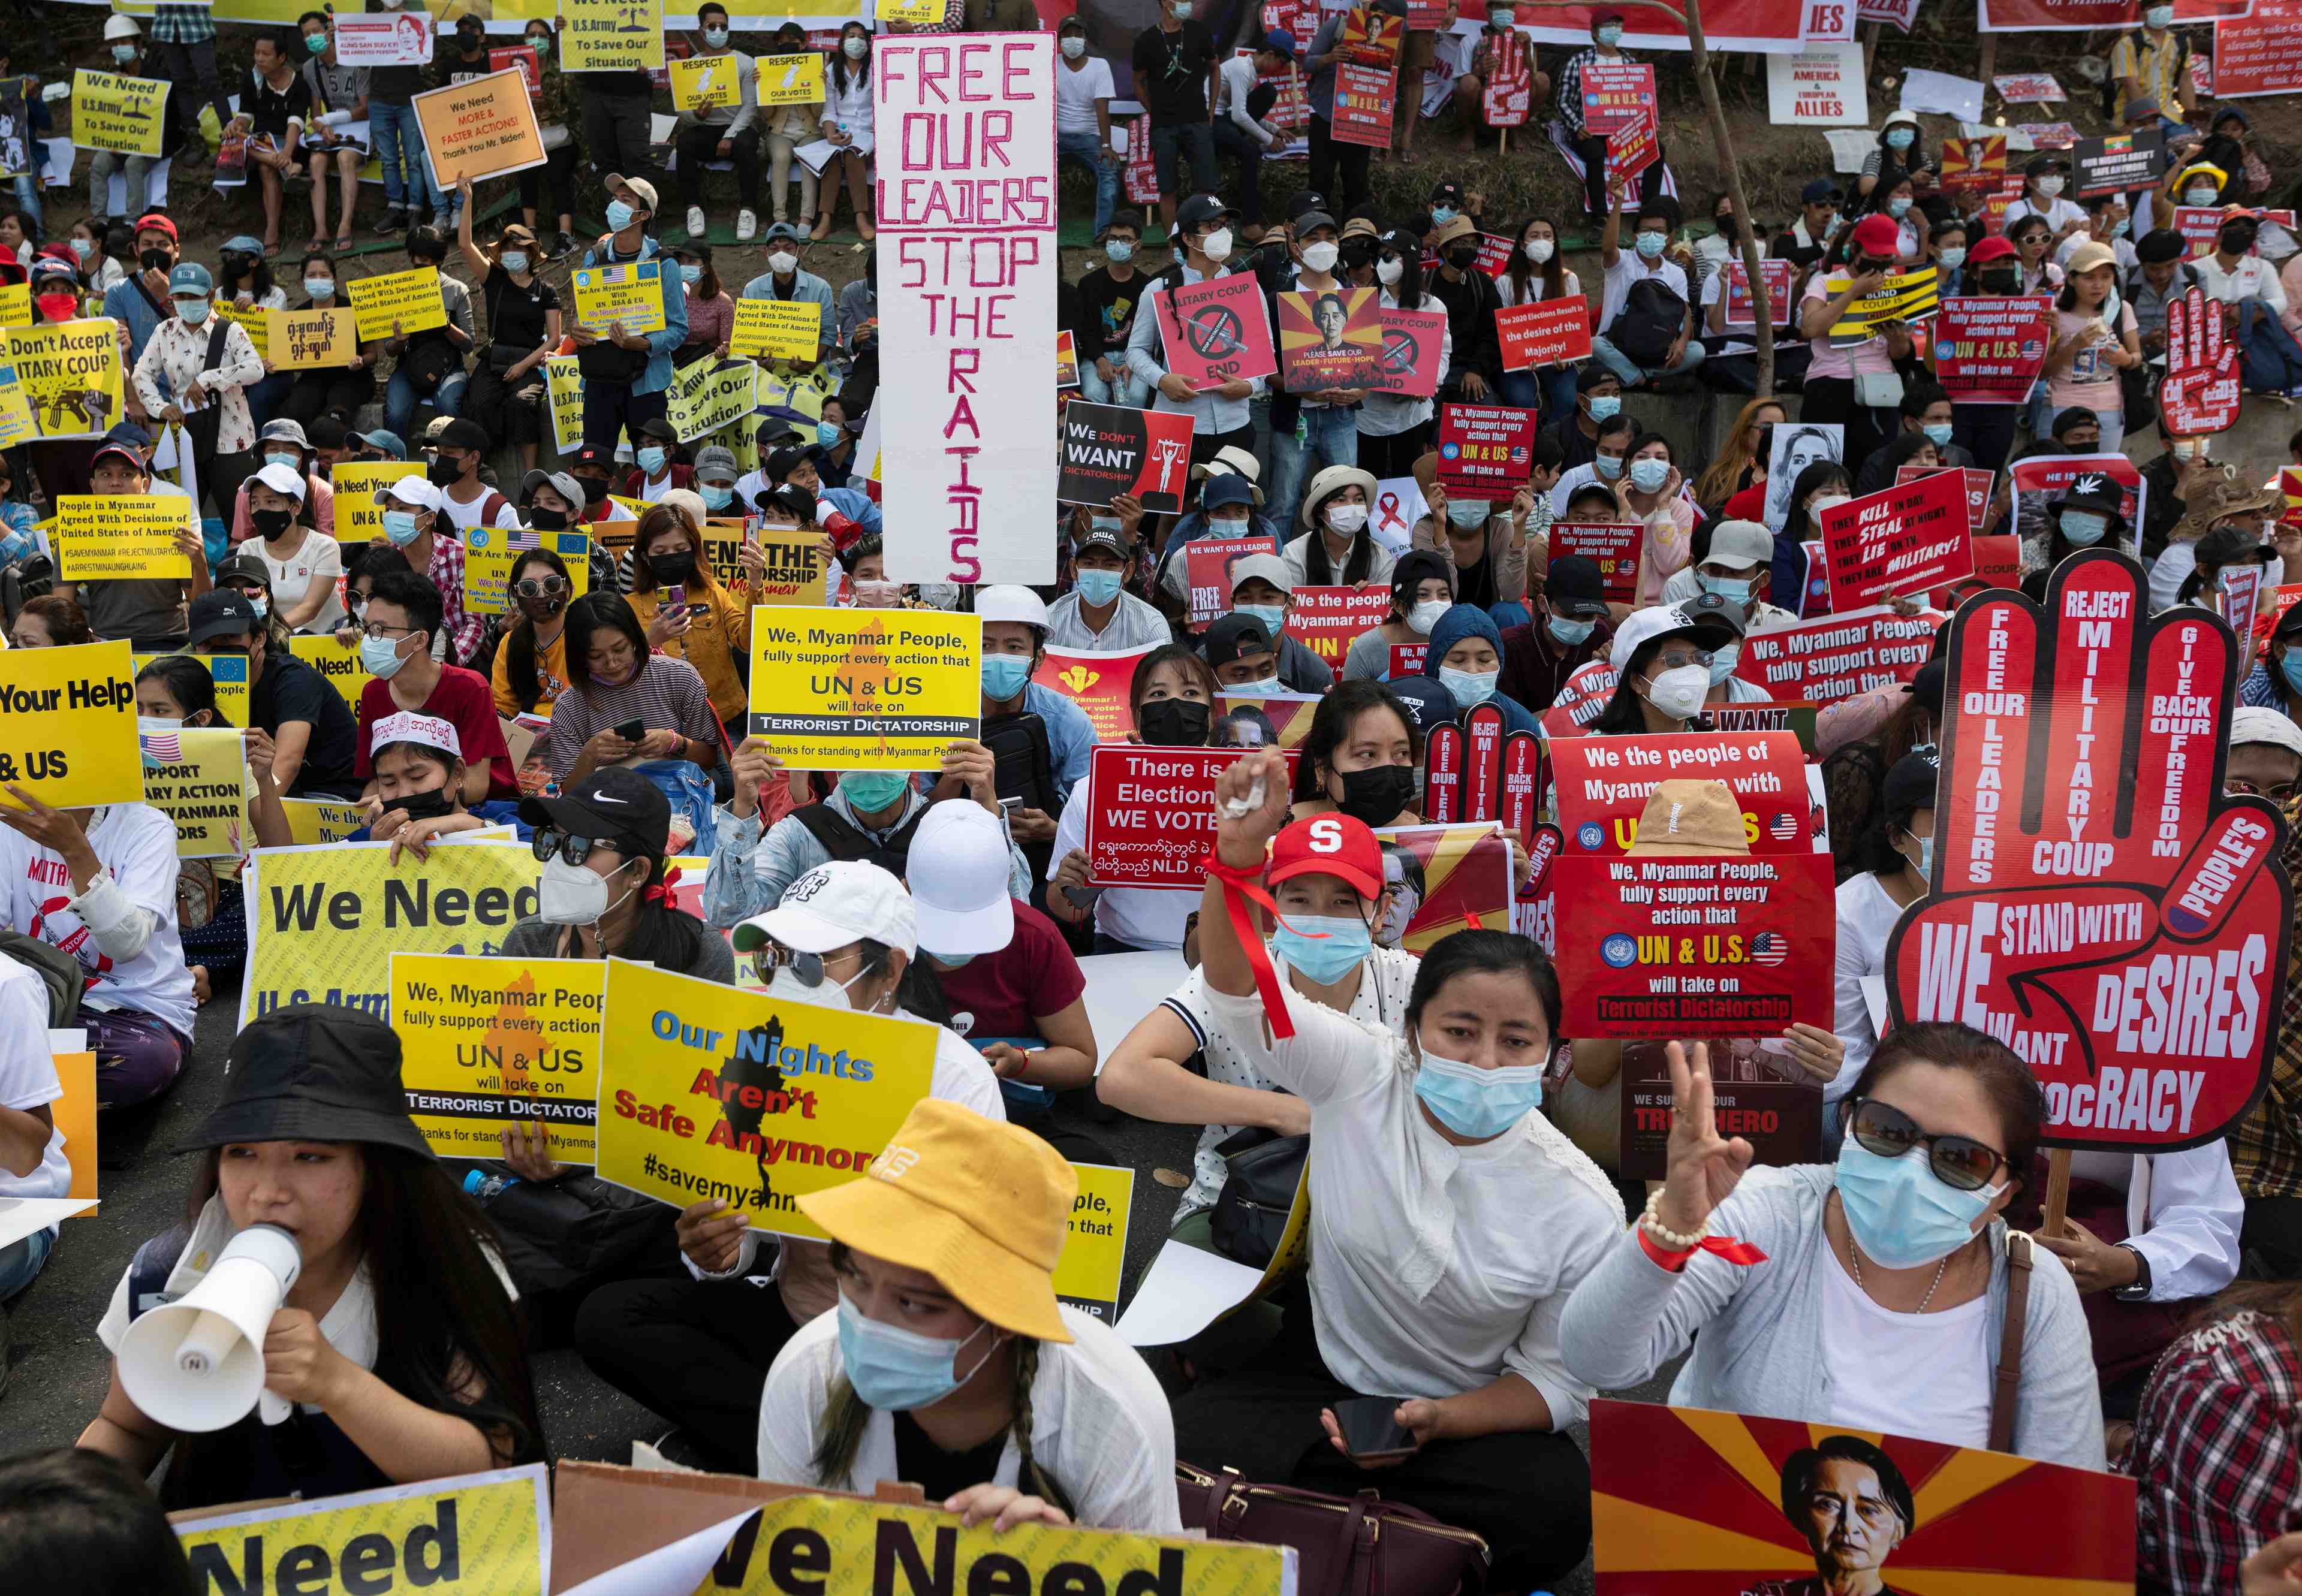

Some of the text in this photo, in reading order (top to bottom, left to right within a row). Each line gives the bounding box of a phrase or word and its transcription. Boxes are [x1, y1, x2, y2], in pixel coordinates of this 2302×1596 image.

[682, 58, 723, 70] RESPECT
[769, 56, 809, 66] RESPECT
[86, 73, 157, 93] We Need
[881, 43, 1036, 104] FREE
[1794, 71, 1840, 81] AMERICA
[450, 93, 494, 113] We Need
[687, 93, 702, 102] OUR
[458, 109, 494, 126] MORE &
[1794, 101, 1843, 116] ALLIES
[85, 119, 149, 134] To Save Our
[442, 117, 519, 145] FASTER ACTIONS!
[92, 136, 140, 150] Situation
[442, 148, 467, 160] Thank
[469, 143, 484, 152] You
[501, 131, 526, 144] Biden!
[902, 111, 1012, 170] OUR
[878, 177, 1048, 225] LEADERS
[900, 237, 1038, 288] STOP
[1164, 283, 1249, 309] MLITARY COUP
[920, 294, 1016, 339] THE
[1408, 319, 1438, 329] COUP
[1512, 315, 1527, 323] 2020
[1528, 311, 1556, 320] Elections
[1557, 306, 1577, 315] Result
[1506, 321, 1581, 342] the desire of the
[11, 331, 111, 357] Don't Accept
[1525, 342, 1566, 357] Majority!
[67, 354, 110, 375] COUP
[1304, 351, 1327, 359] PLEASE
[1206, 361, 1240, 379] END
[1099, 432, 1136, 445] DON'T
[1068, 443, 1136, 469] WANT
[1064, 466, 1132, 482] DICTATORSHIP!
[59, 501, 156, 512] People in Myanmar
[1831, 516, 1854, 531] THEY
[1859, 501, 1890, 525] KILL
[1894, 501, 1904, 512] IN
[60, 514, 188, 526] Agreed With Decisions of
[61, 527, 142, 538] United States of
[1833, 517, 1915, 550] THEY STEAL AT
[65, 548, 116, 558] #SAVEMYANMAR
[1837, 554, 1860, 569] THEY
[1862, 542, 1886, 564] LIE
[1890, 541, 1903, 552] ON
[1839, 535, 1961, 586] THEY ARE MILITARY!
[1192, 586, 1220, 611] FREE
[2066, 591, 2130, 618] REJECT
[768, 628, 967, 651] We, Myanmar People,
[1985, 609, 2010, 691] FREE
[764, 650, 971, 666] fully support every action that
[2177, 627, 2197, 695] GIVE
[0, 676, 134, 714] Your Help
[811, 675, 922, 695] UN & US
[827, 701, 904, 712] will take on
[1964, 692, 2026, 716] OUR
[2152, 695, 2212, 718] BACK
[2150, 717, 2210, 735] OUR
[802, 745, 815, 755] for
[818, 745, 860, 758] standing
[869, 746, 884, 756] with
[887, 747, 932, 758] Myanmar
[1584, 740, 1768, 768] We the people of
[28, 750, 68, 779] US
[1126, 758, 1222, 778] There is
[178, 783, 240, 799] ACTION
[1738, 773, 1781, 792] with
[1119, 783, 1215, 804] Election
[1107, 809, 1147, 828] WE
[1309, 820, 1342, 853] S
[1153, 859, 1189, 873] NLD
[2032, 841, 2114, 877] COUP
[2178, 817, 2267, 917] PEOPLE'S
[1610, 862, 1779, 881] We, Myanmar People,
[270, 876, 542, 933] We Need
[1620, 885, 1768, 904] fully support every
[1652, 907, 1737, 924] action that
[1638, 935, 1750, 964] UN & U.S.
[1918, 901, 2143, 1033] WE STAND WITH
[1649, 976, 1739, 993] will take on
[2092, 934, 2267, 1058] DESIRES
[1599, 998, 1789, 1019] Terrorist Dictatorship
[652, 1009, 875, 1082] Our Nights
[1987, 1012, 2068, 1066] WANT
[690, 1069, 819, 1120] Aren't
[614, 1089, 879, 1173] Safe Anymor
[189, 1498, 460, 1596] Need
